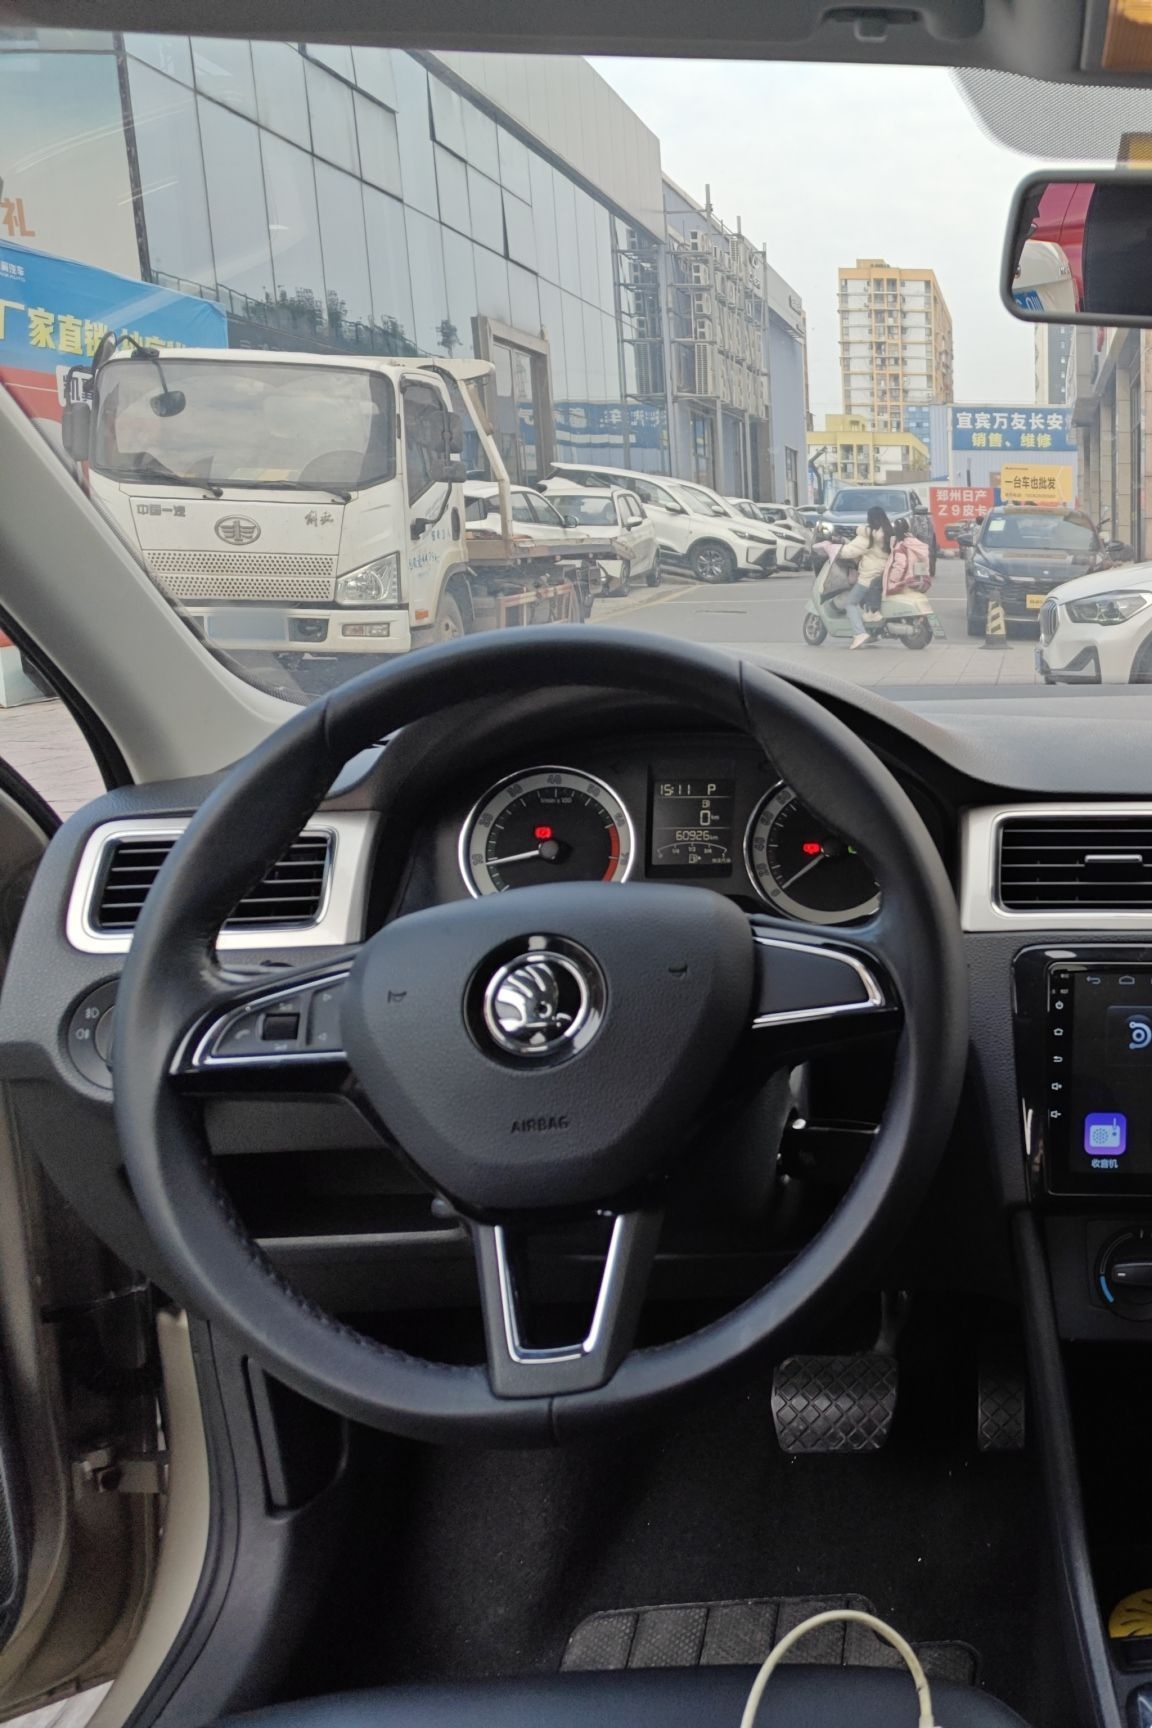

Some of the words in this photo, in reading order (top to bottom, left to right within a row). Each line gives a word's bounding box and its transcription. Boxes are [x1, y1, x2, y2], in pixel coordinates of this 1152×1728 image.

[0, 198, 35, 237] 礼
[1005, 476, 1056, 490] 一台车也批发
[936, 490, 987, 501] 郑州日产
[137, 504, 186, 517] 中国一汽
[660, 784, 691, 796] 15:11
[707, 784, 716, 795] P
[700, 810, 711, 826] 0
[676, 830, 710, 841] 60926
[511, 1116, 571, 1134] AIRBAG
[1091, 1159, 1119, 1169] 收音机
